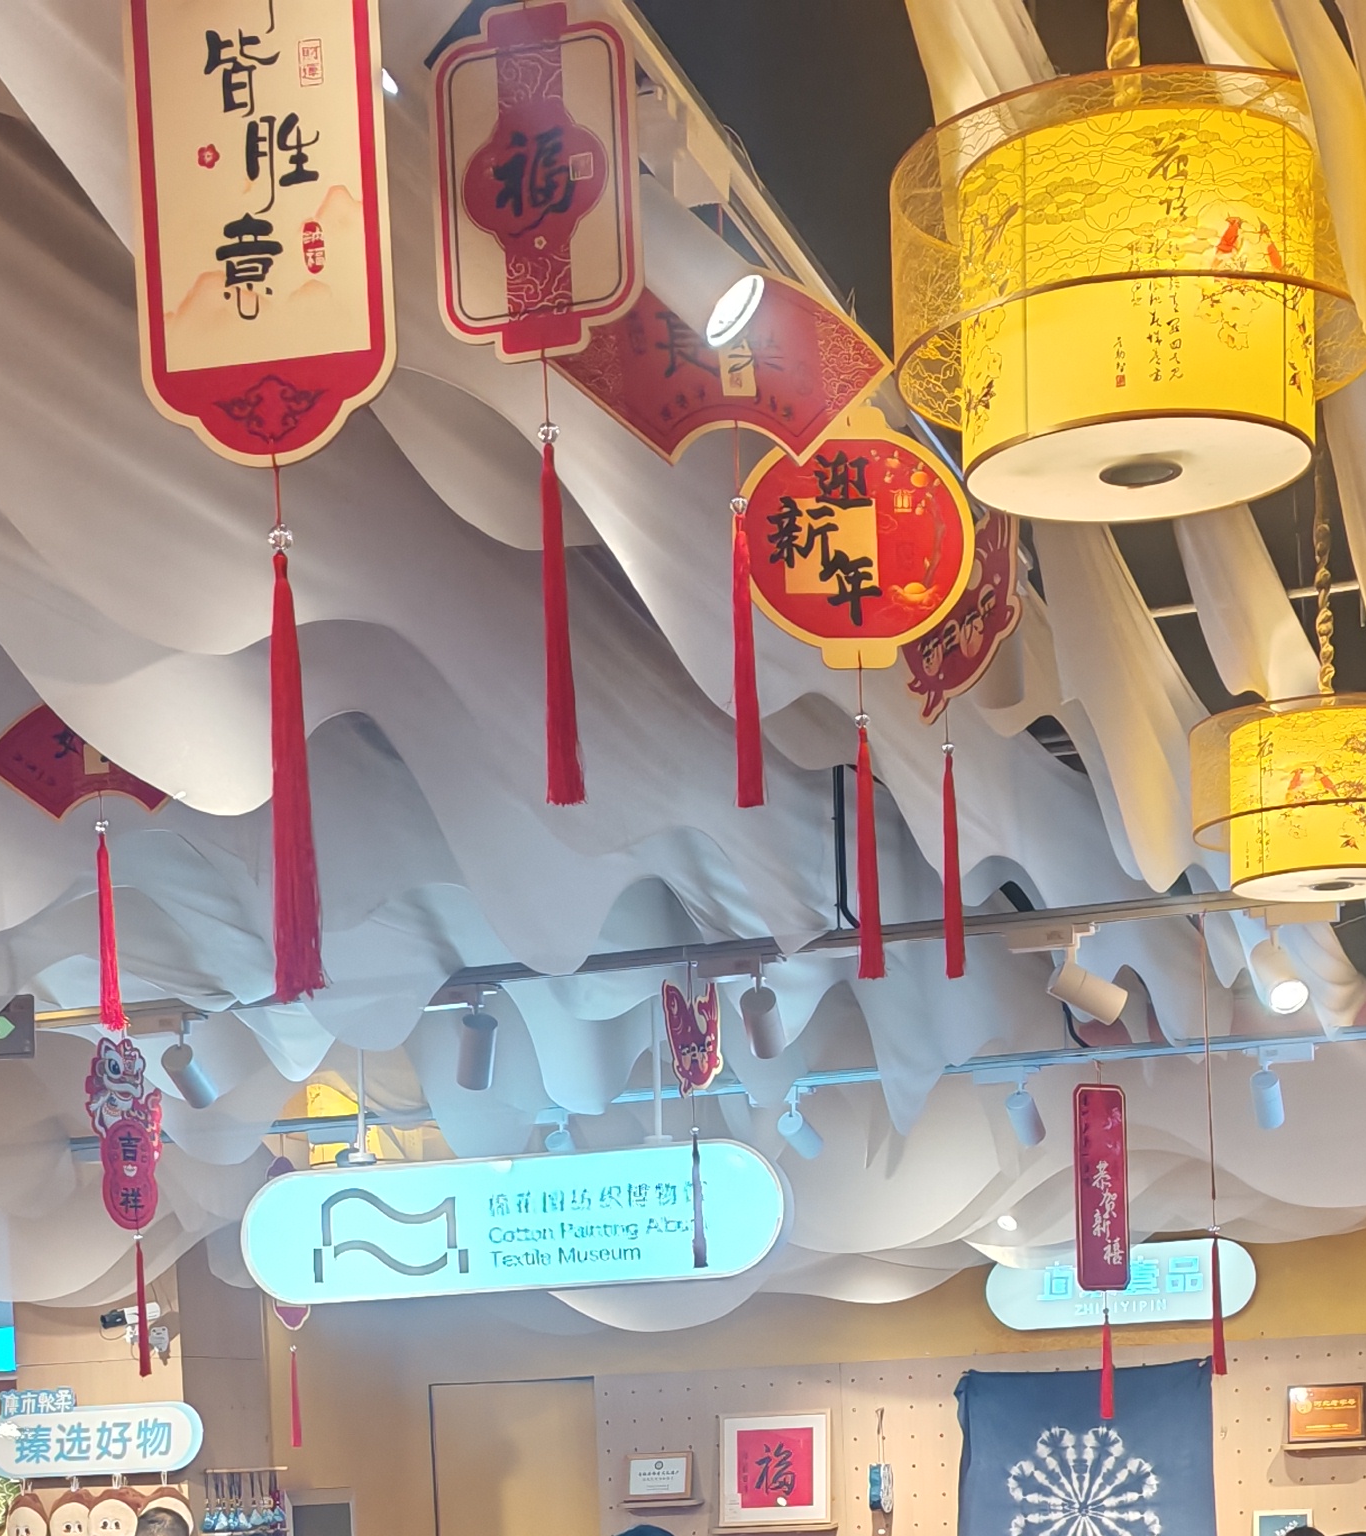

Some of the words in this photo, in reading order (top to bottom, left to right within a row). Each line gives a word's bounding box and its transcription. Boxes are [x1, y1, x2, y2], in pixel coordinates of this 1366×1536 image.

[203, 0, 320, 320] 皆胜意
[492, 126, 577, 238] 福
[118, 1131, 145, 1214] 吉祥
[488, 1226, 556, 1244] Cotton
[560, 1219, 639, 1240] Painting
[645, 1217, 710, 1235] Albu
[490, 1249, 552, 1267] Textile
[558, 1245, 642, 1265] Museum
[1037, 1255, 1204, 1301] 直壹品
[1074, 1299, 1168, 1316] ZHIIYIPIN
[14, 1417, 173, 1465] 臻选好物
[755, 1442, 796, 1495] 福
